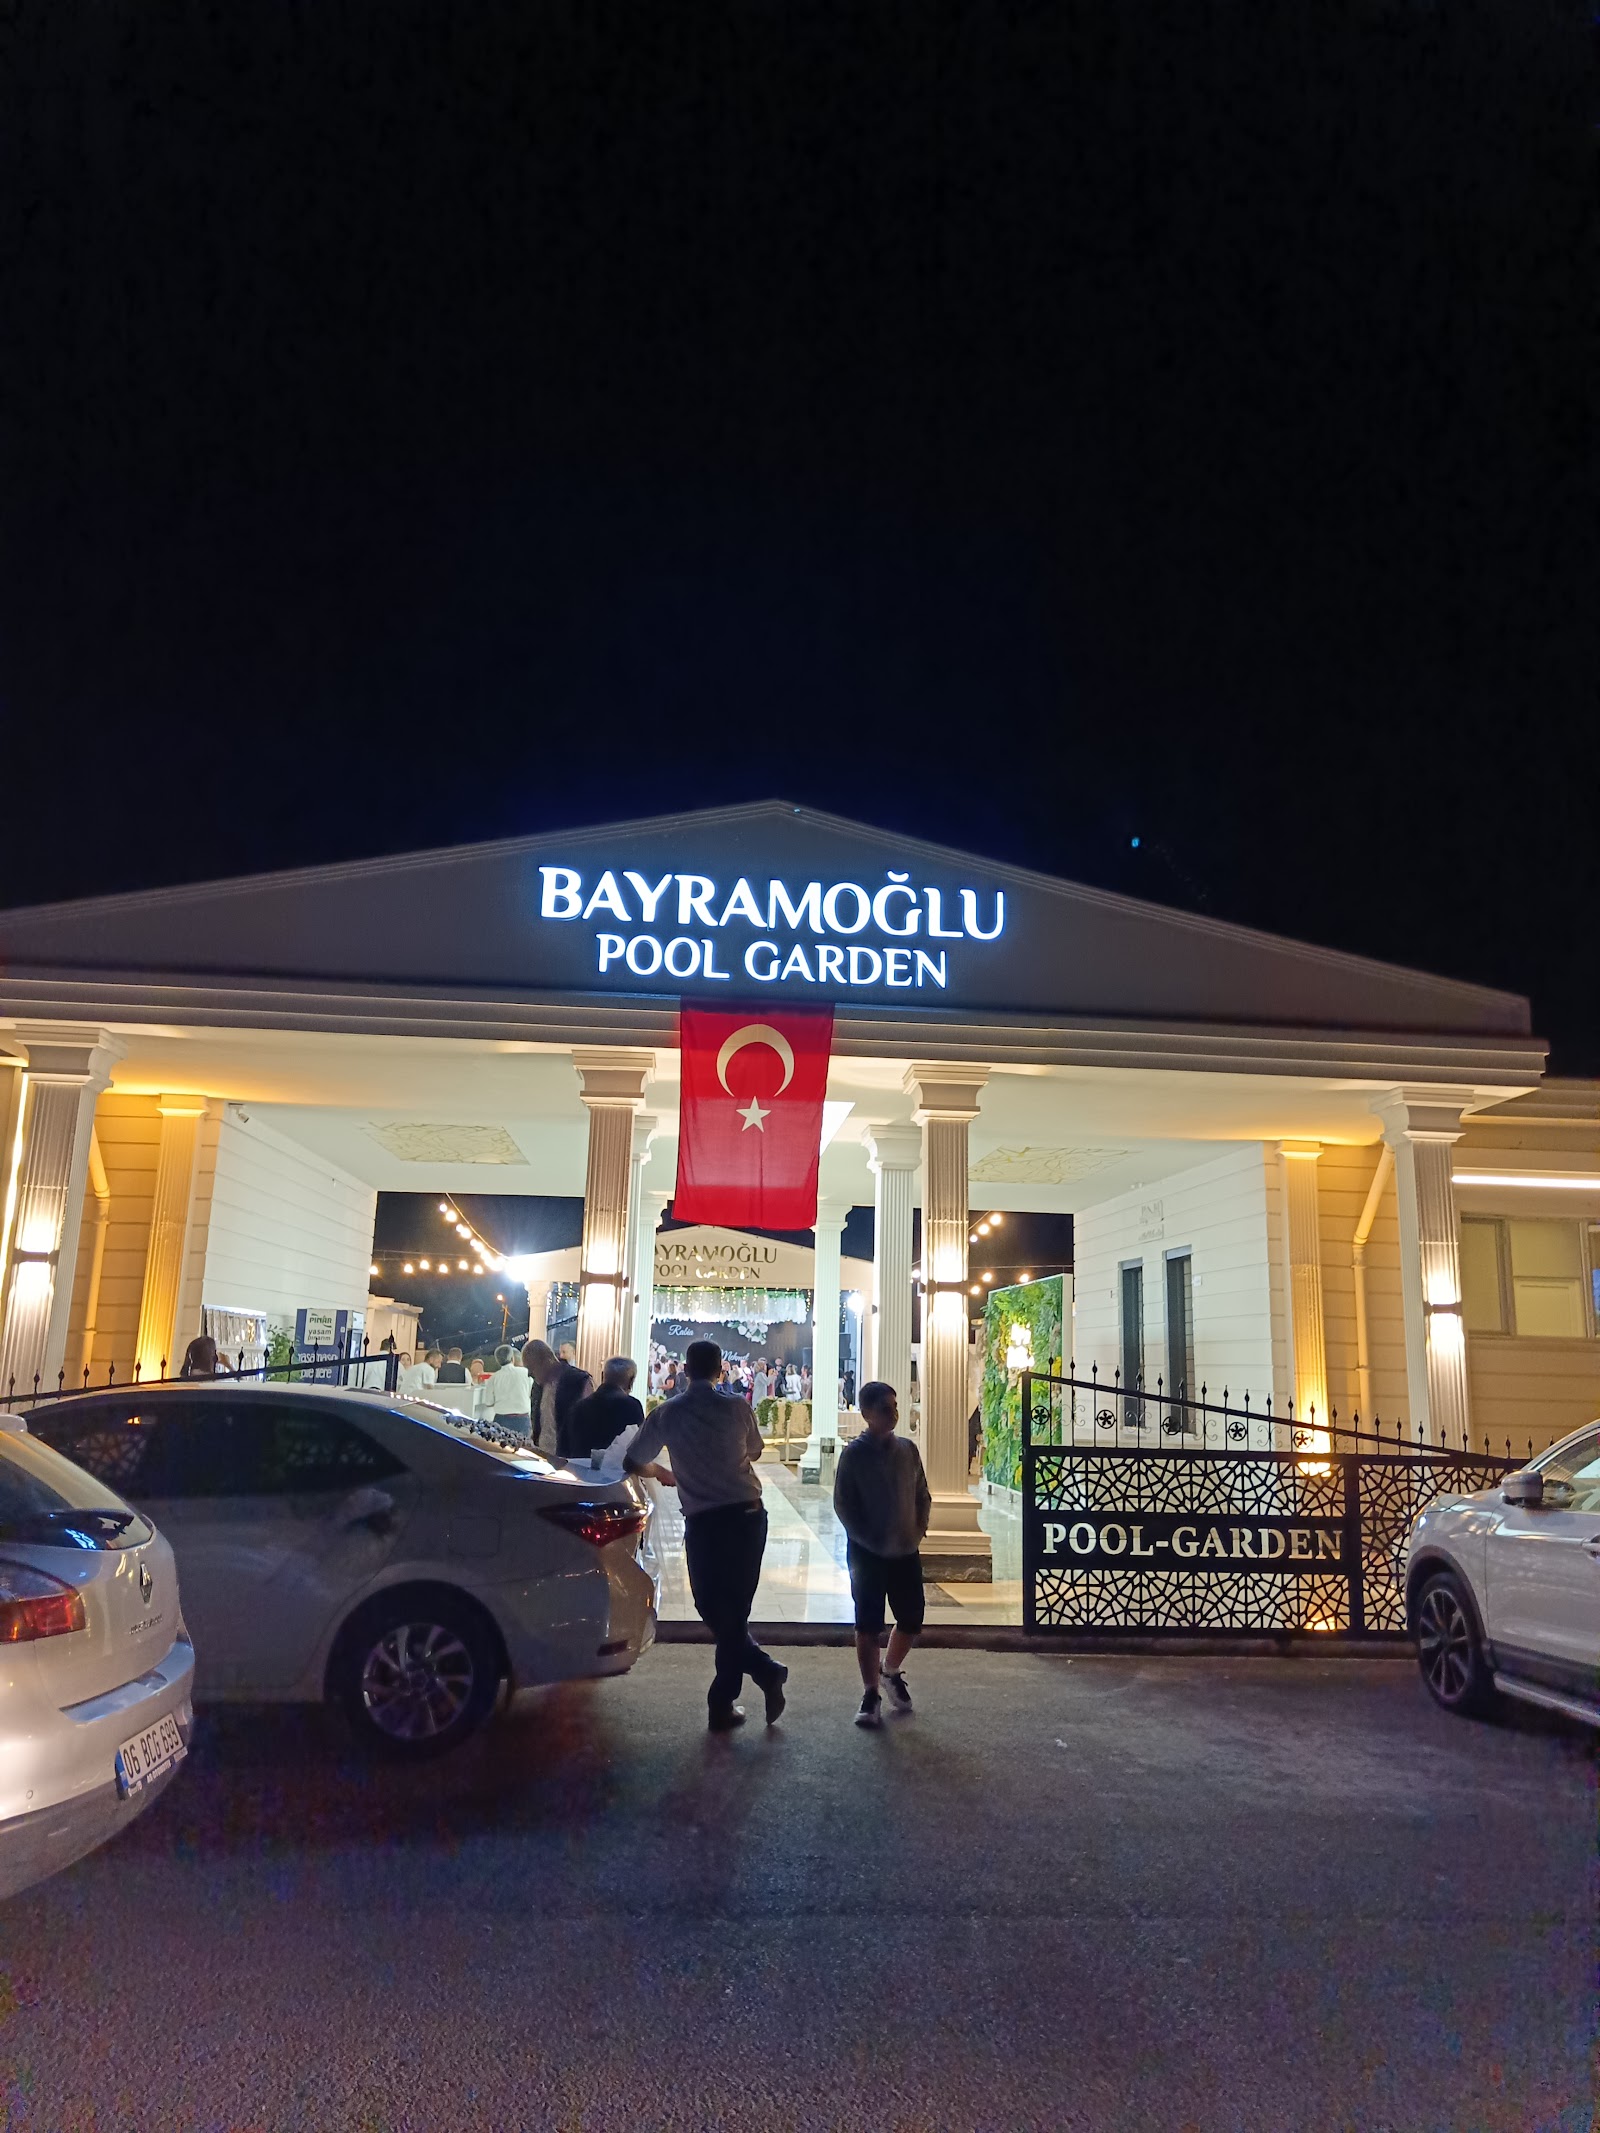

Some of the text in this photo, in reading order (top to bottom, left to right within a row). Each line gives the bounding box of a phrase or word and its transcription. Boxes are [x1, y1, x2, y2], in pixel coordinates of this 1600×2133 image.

[538, 866, 1004, 941] BAYRAMOĞLU
[596, 933, 947, 989] POOL GARDEN
[655, 1242, 777, 1264] YRAMOĞLU
[668, 1324, 694, 1336] Rabia
[1041, 1522, 1343, 1561] POOL-GARDEN
[123, 1743, 141, 1779] 06
[140, 1730, 162, 1768] BCG
[160, 1719, 179, 1754] 699
